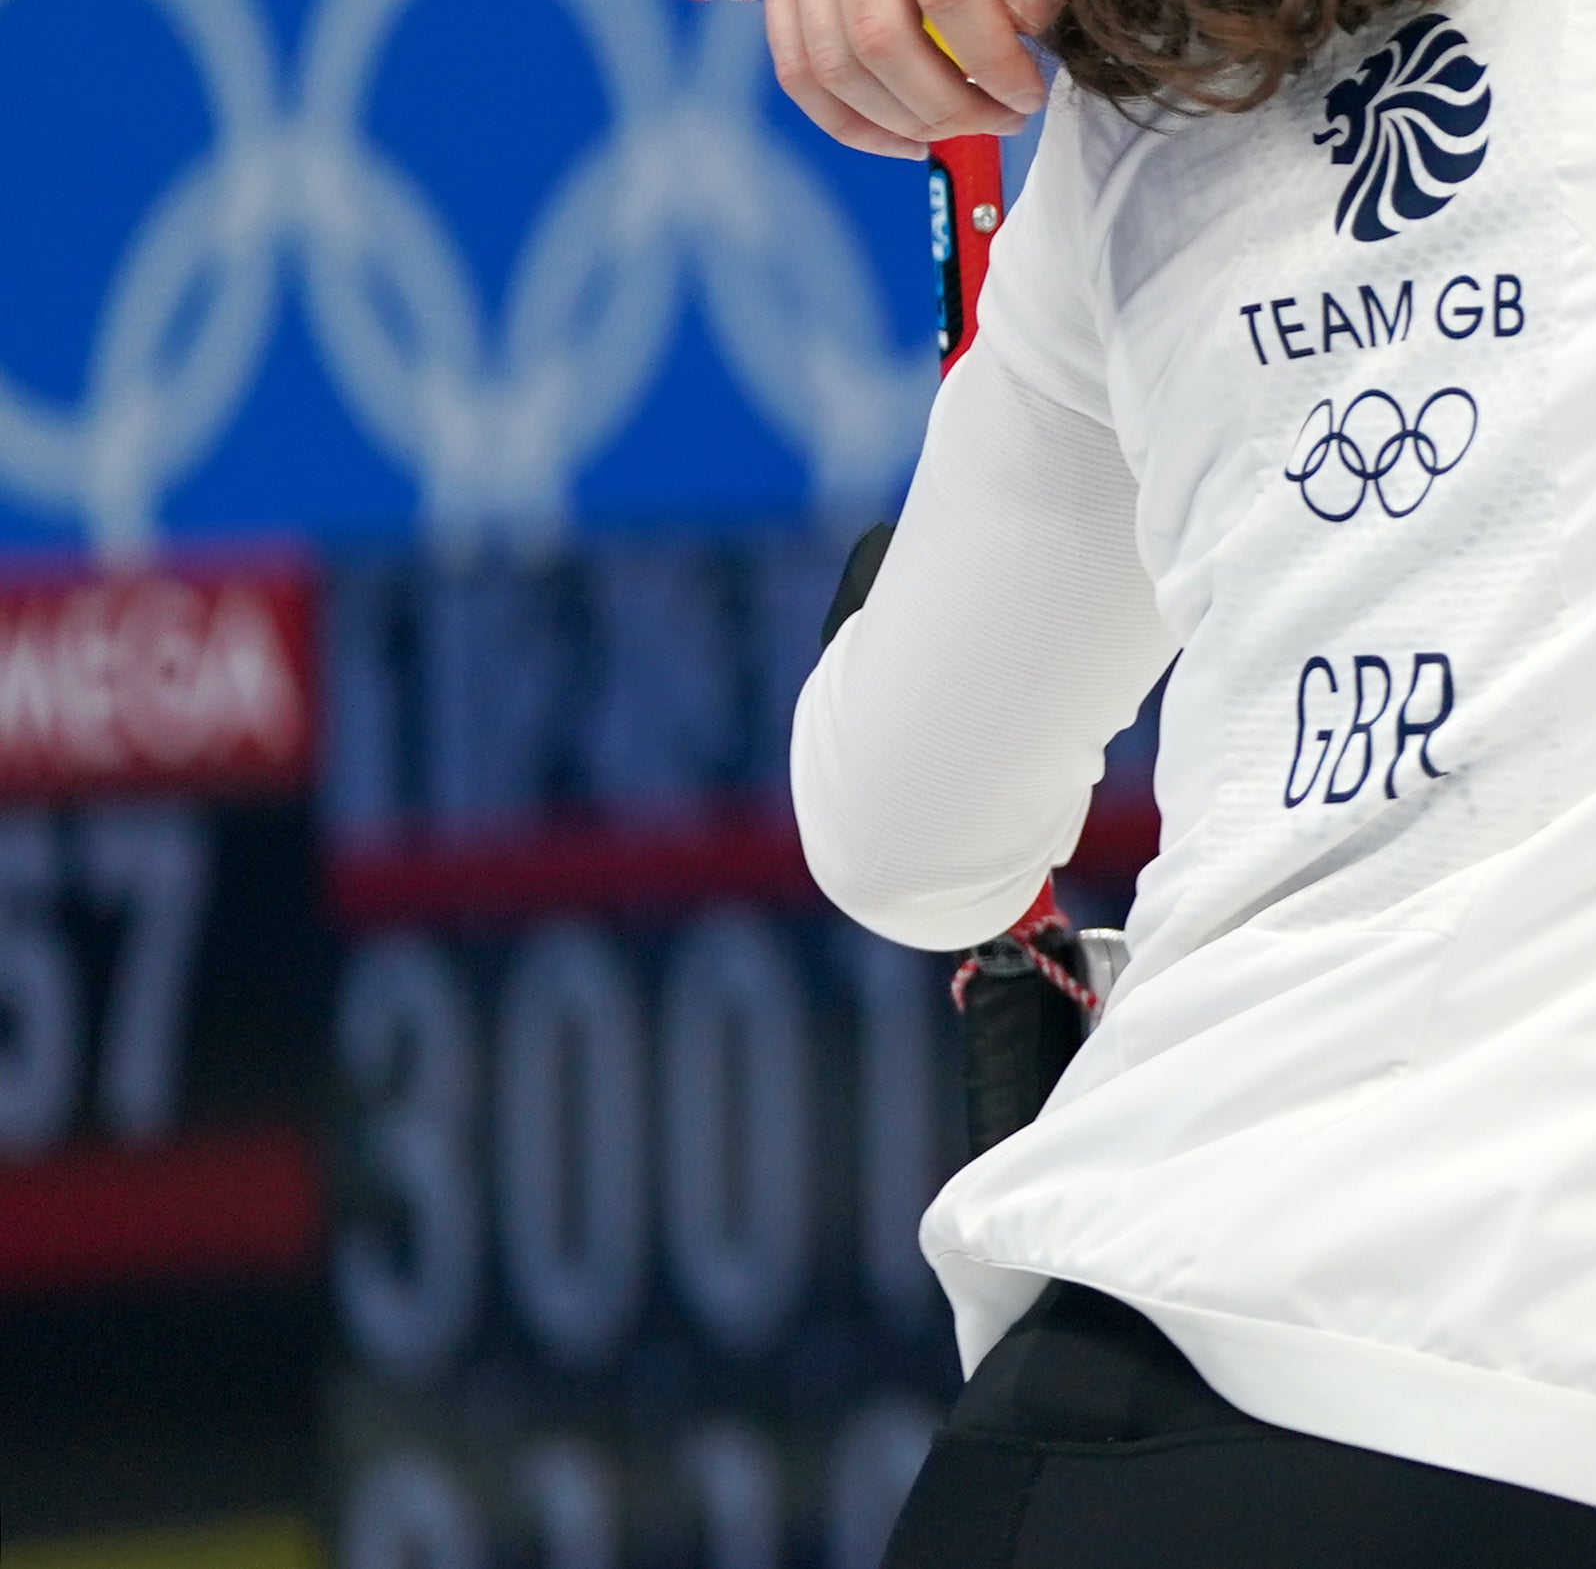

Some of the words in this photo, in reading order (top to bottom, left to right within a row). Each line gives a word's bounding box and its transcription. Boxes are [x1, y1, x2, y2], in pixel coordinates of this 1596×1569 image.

[1239, 280, 1413, 366] TEAM
[1435, 273, 1526, 341] GB
[1283, 652, 1455, 809] GBR
